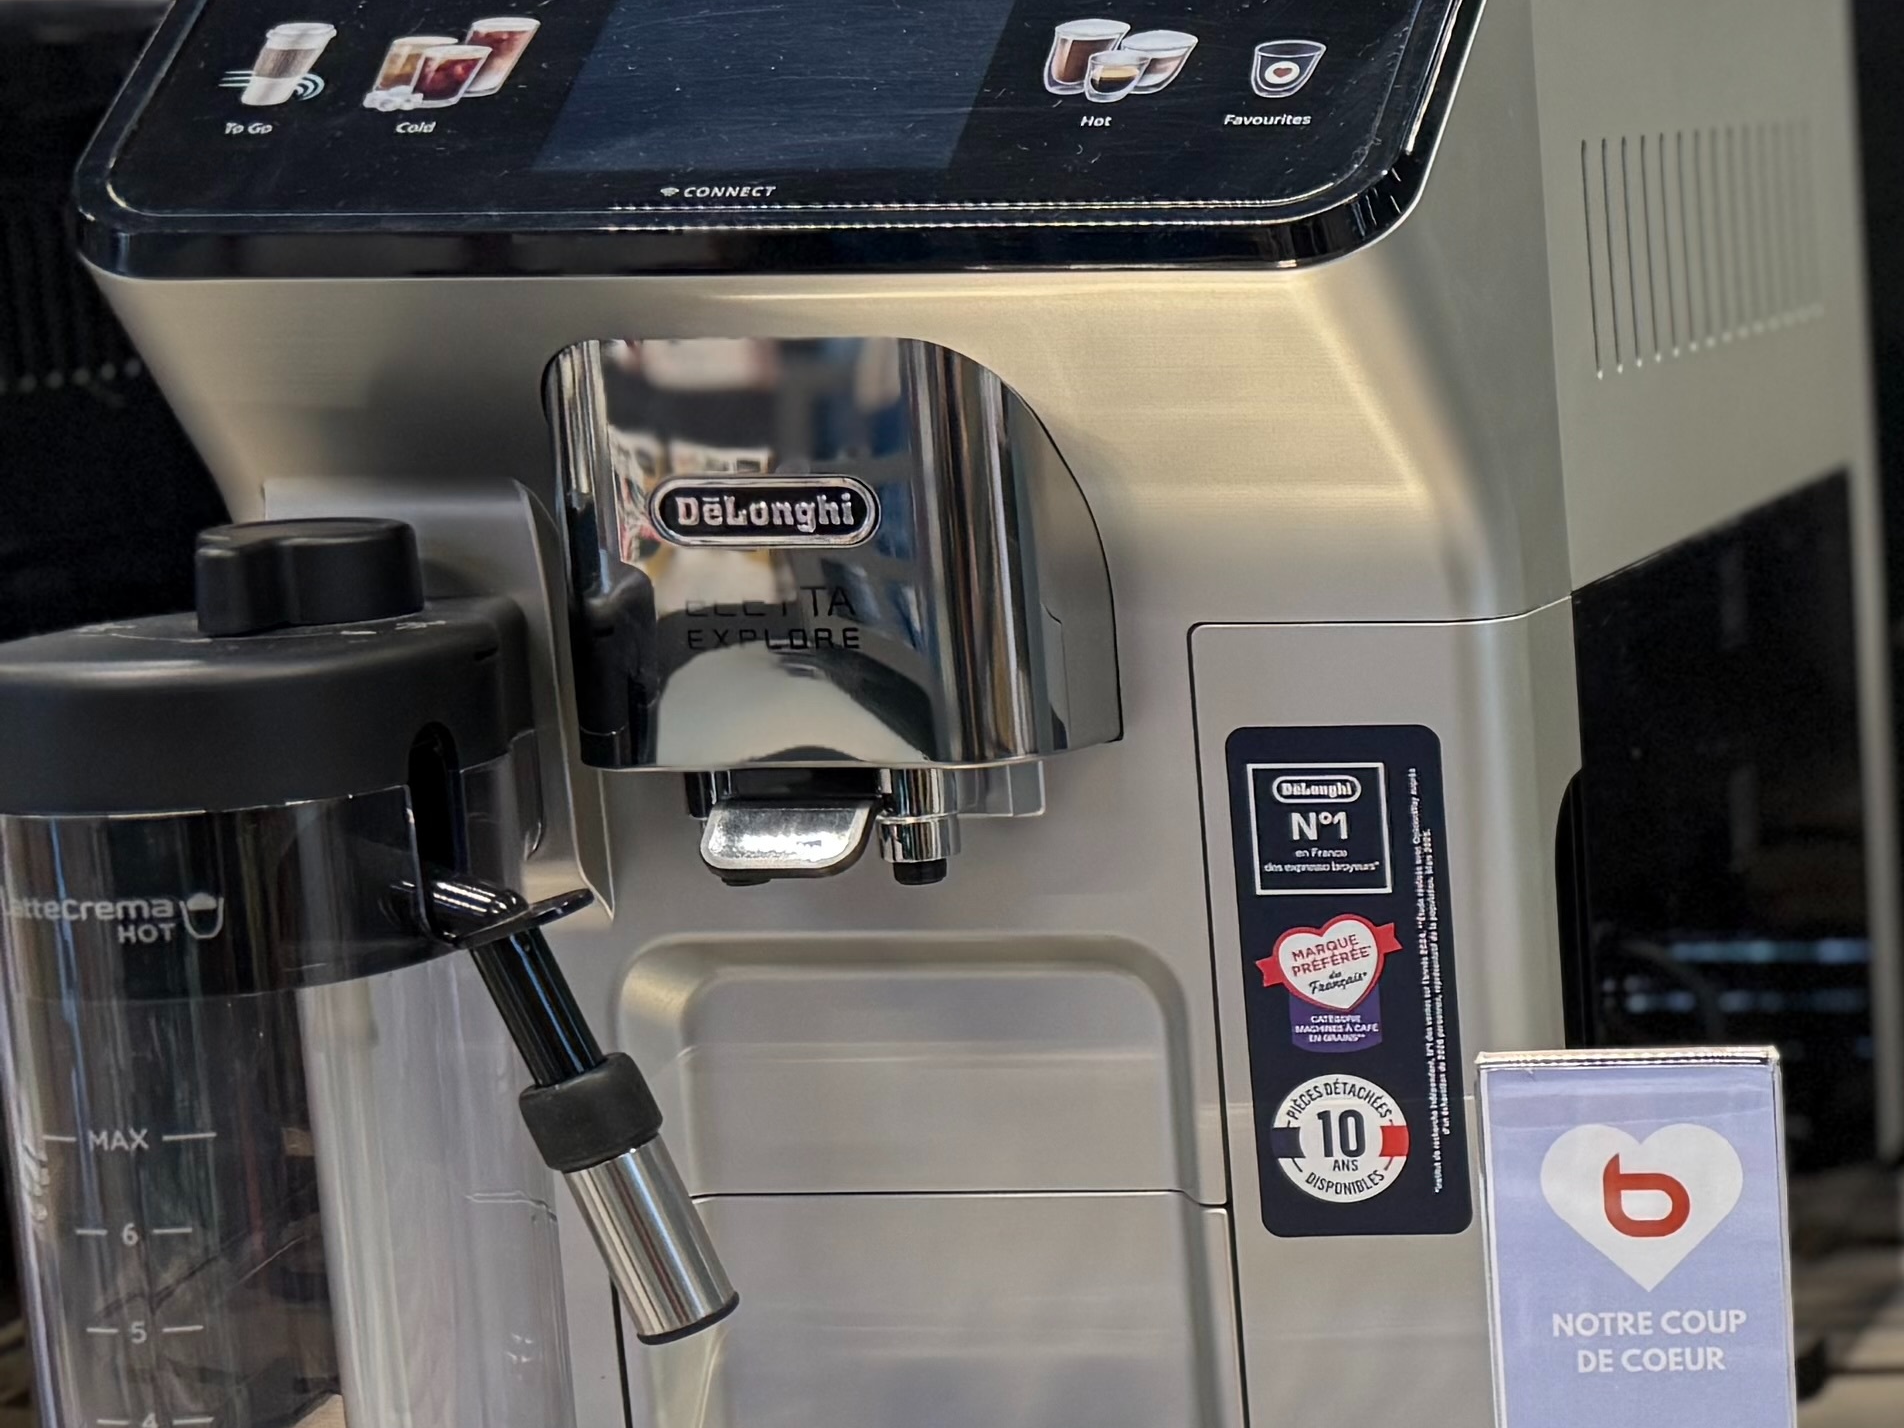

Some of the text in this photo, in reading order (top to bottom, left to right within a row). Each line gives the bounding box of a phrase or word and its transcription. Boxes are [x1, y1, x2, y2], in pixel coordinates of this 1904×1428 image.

[224, 122, 274, 134] To Go
[396, 121, 436, 134] Cold
[1080, 114, 1112, 127] Hot
[1224, 114, 1311, 126] Favourites
[684, 186, 777, 198] CONNECT
[688, 627, 860, 649] EXPLORE
[118, 924, 175, 943] HOT
[1291, 935, 1359, 961] MARQUE
[1292, 946, 1371, 976] PRÉFÉRÉE
[1287, 1081, 1392, 1120] PIÈCES DÉTACHÉES
[88, 1128, 149, 1151] MAX
[1317, 1109, 1366, 1158] 10
[1333, 1159, 1358, 1171] ANS
[1306, 1170, 1384, 1195] DISPONIBLES
[122, 1222, 139, 1246] 6
[130, 1323, 146, 1343] 5
[1552, 1309, 1747, 1337] NOTRE COUP
[1577, 1344, 1726, 1373] DE COEUR
